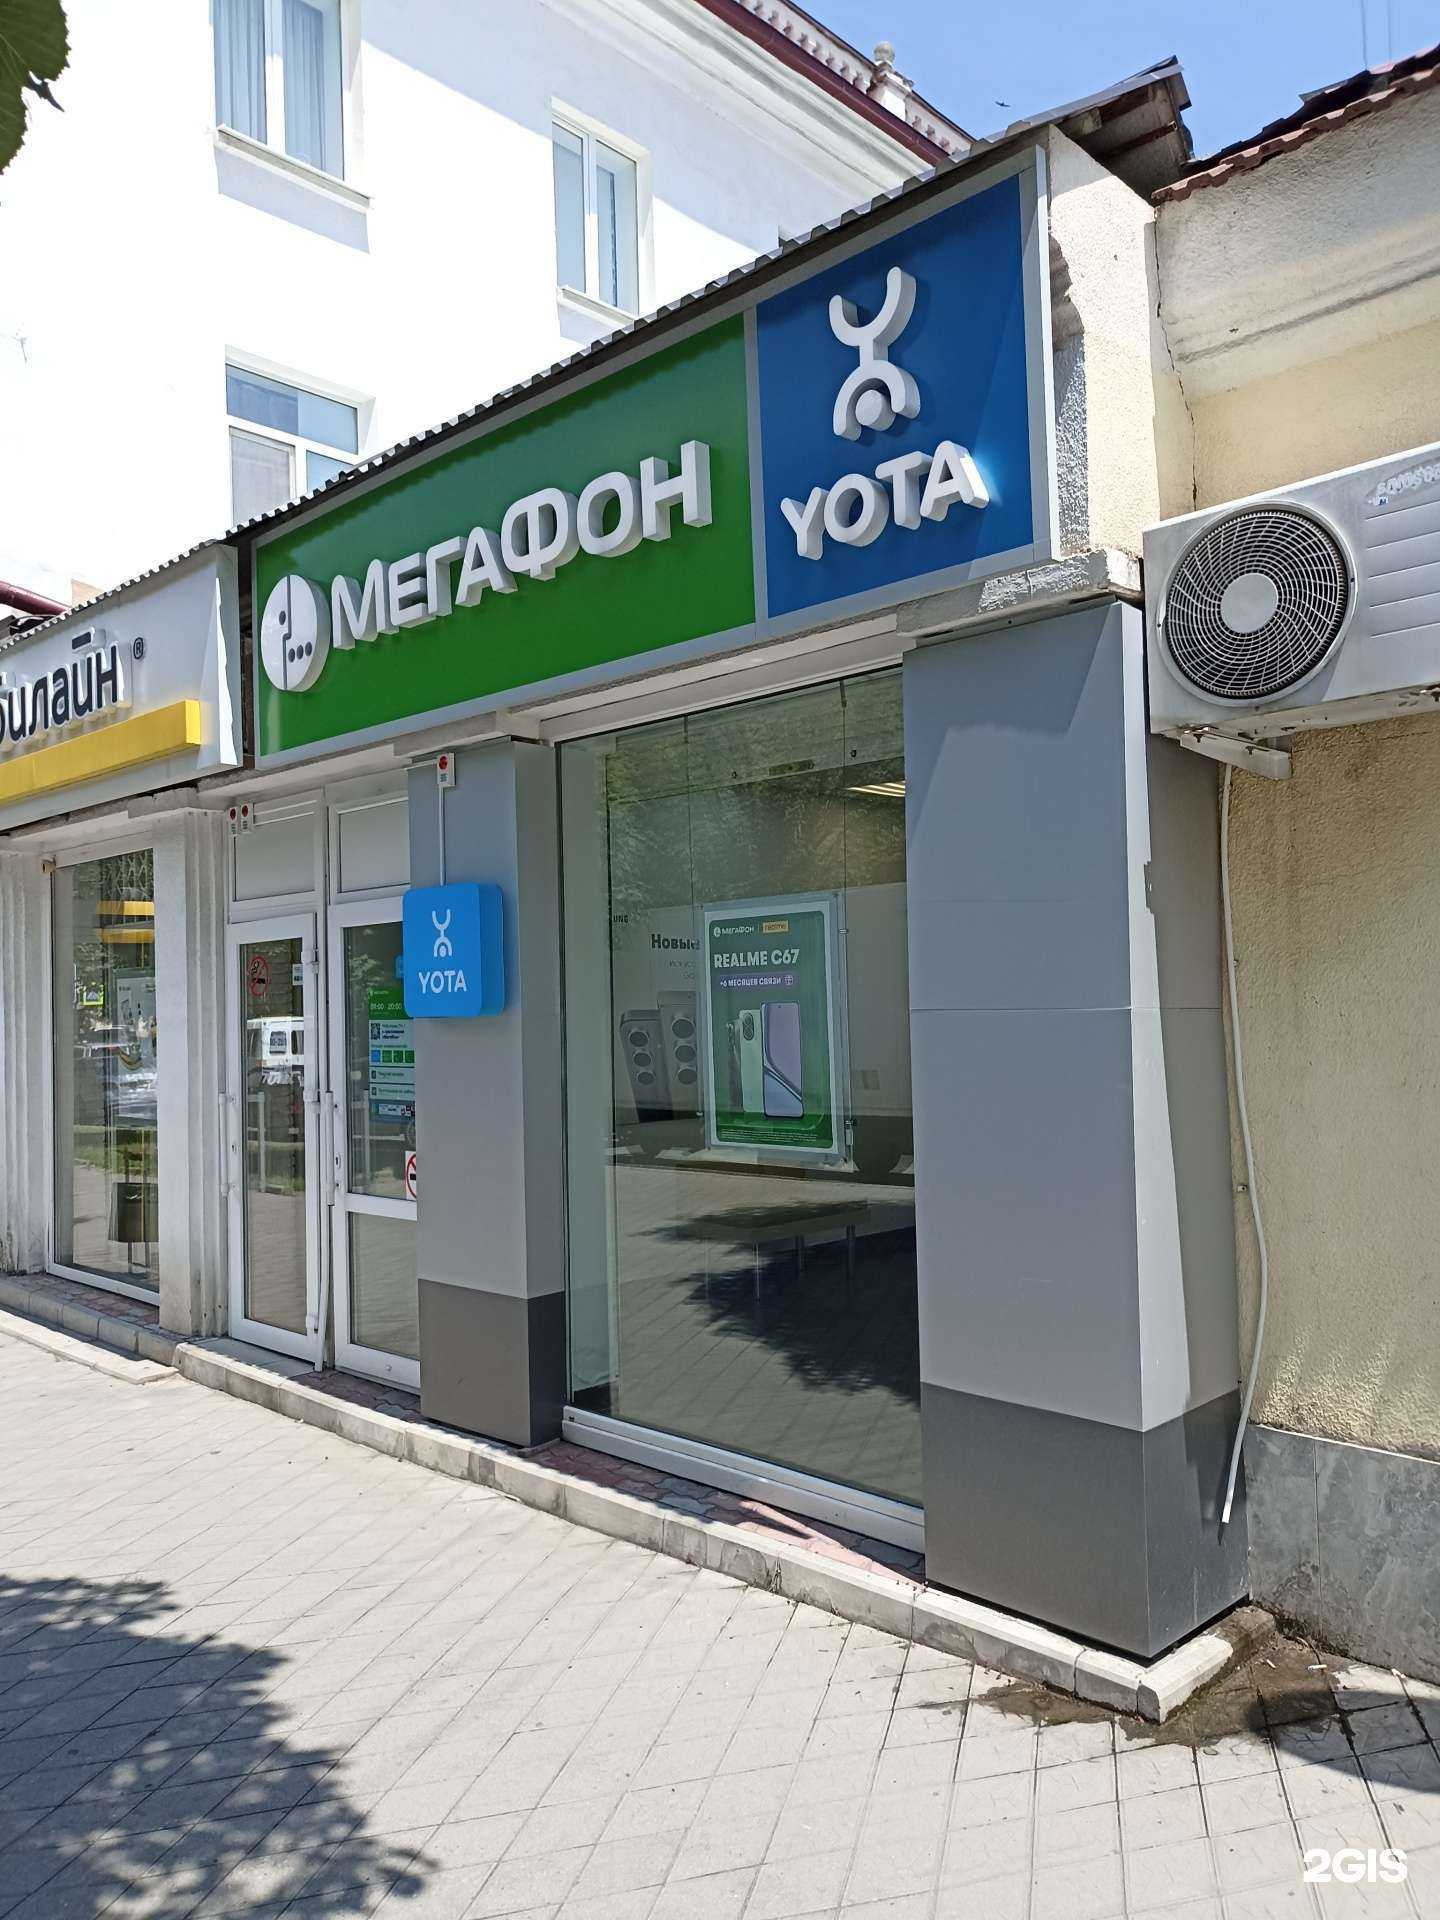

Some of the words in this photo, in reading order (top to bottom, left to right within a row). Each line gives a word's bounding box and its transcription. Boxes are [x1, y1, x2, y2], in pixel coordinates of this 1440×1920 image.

[780, 440, 990, 560] YOTA
[331, 440, 712, 649] МЕГАФОН
[418, 969, 467, 994] YOTA
[714, 951, 768, 969] REALME
[770, 948, 800, 965] C67
